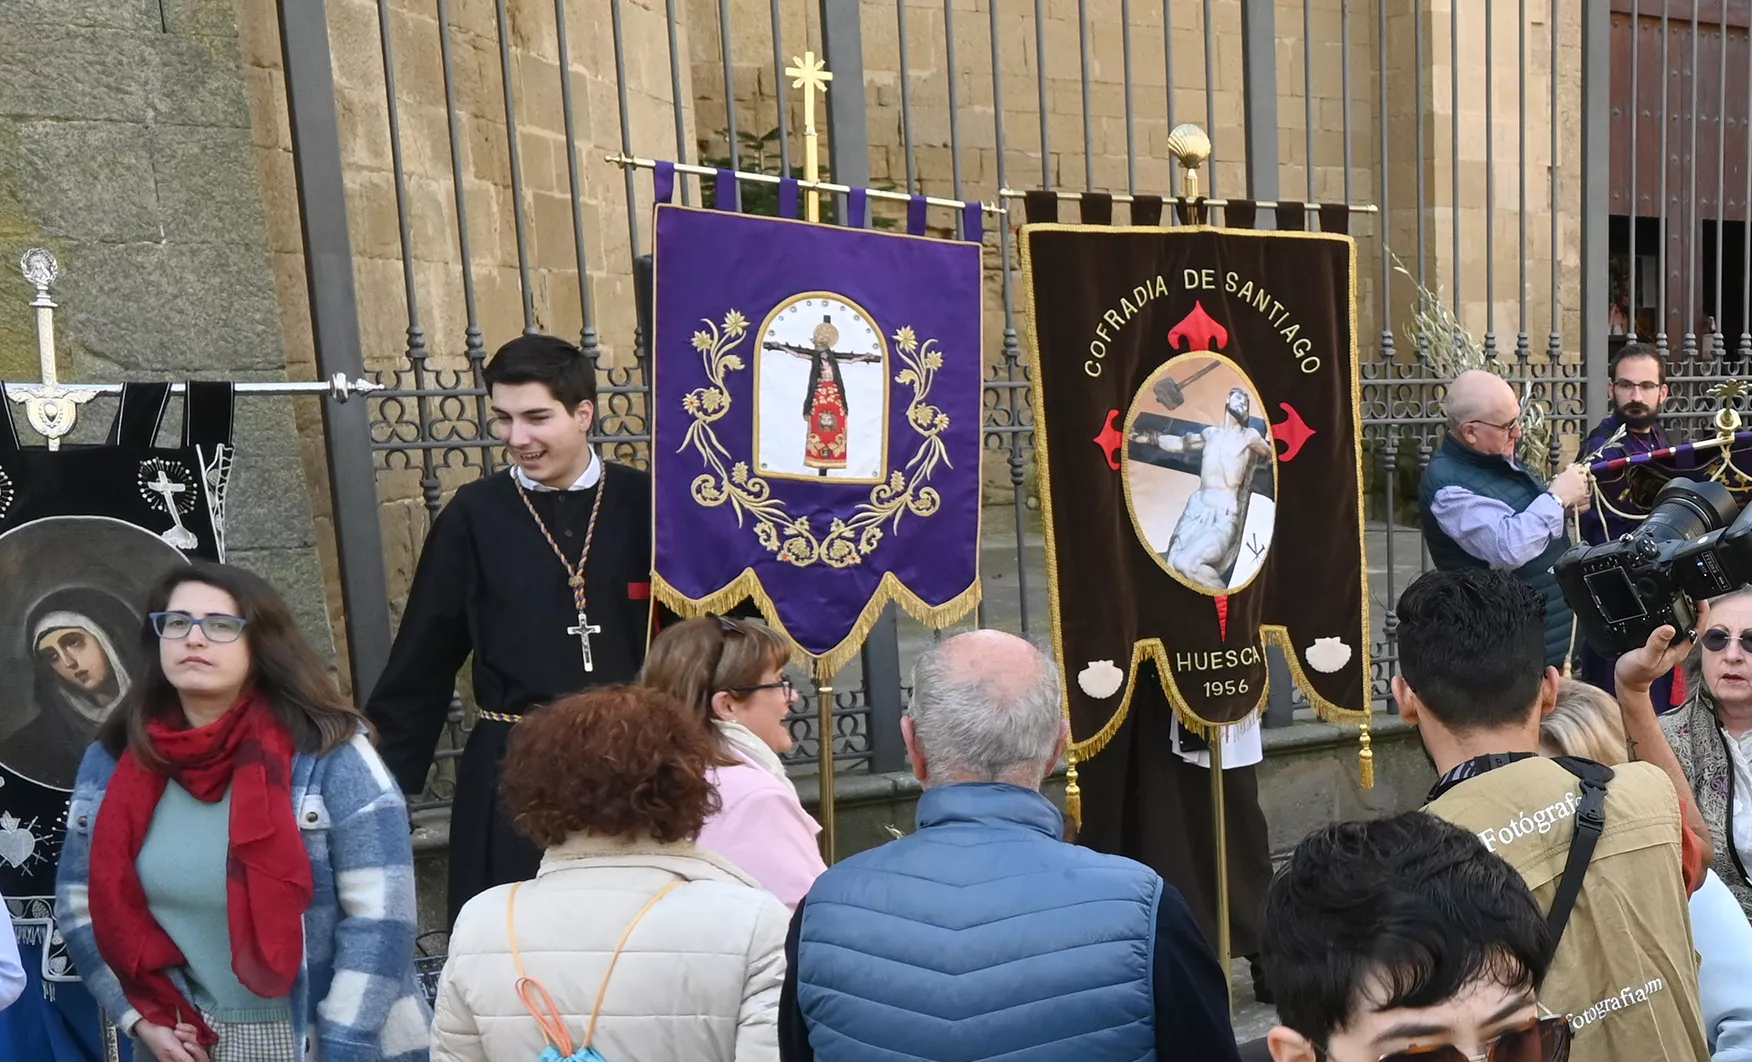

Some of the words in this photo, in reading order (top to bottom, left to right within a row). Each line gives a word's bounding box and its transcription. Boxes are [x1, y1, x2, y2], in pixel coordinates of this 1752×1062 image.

[1183, 268, 1216, 290] DE
[1224, 271, 1321, 374] SANTIAGO
[1176, 645, 1261, 672] HUESCA
[1203, 678, 1249, 698] 1956
